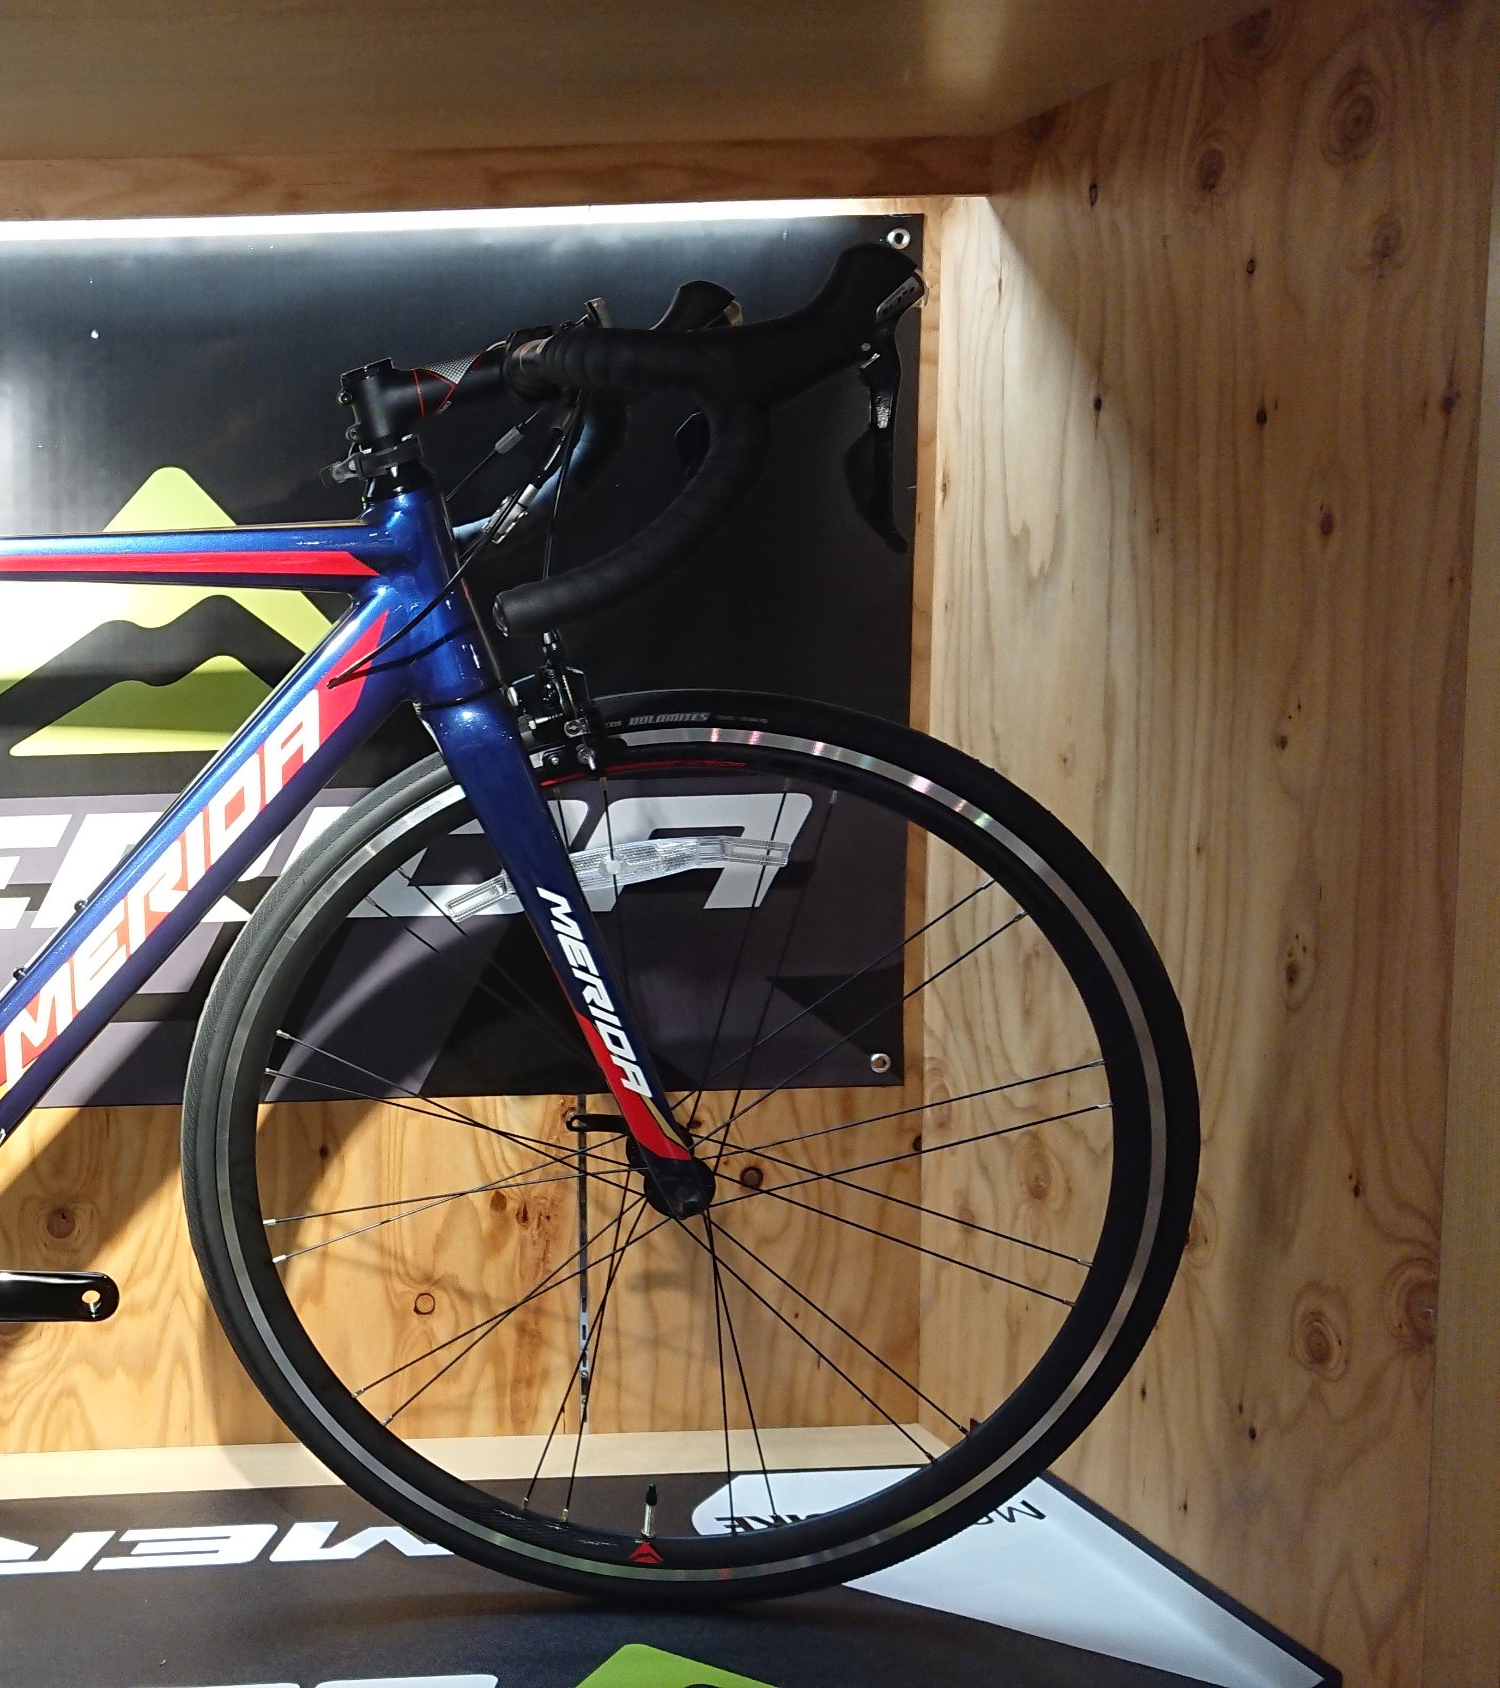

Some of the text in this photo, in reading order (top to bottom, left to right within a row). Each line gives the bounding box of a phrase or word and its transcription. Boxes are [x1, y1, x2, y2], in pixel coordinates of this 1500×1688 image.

[628, 712, 711, 726] DOLOMITES
[2, 689, 320, 1090] MERIDA
[536, 886, 654, 1098] MERIDA
